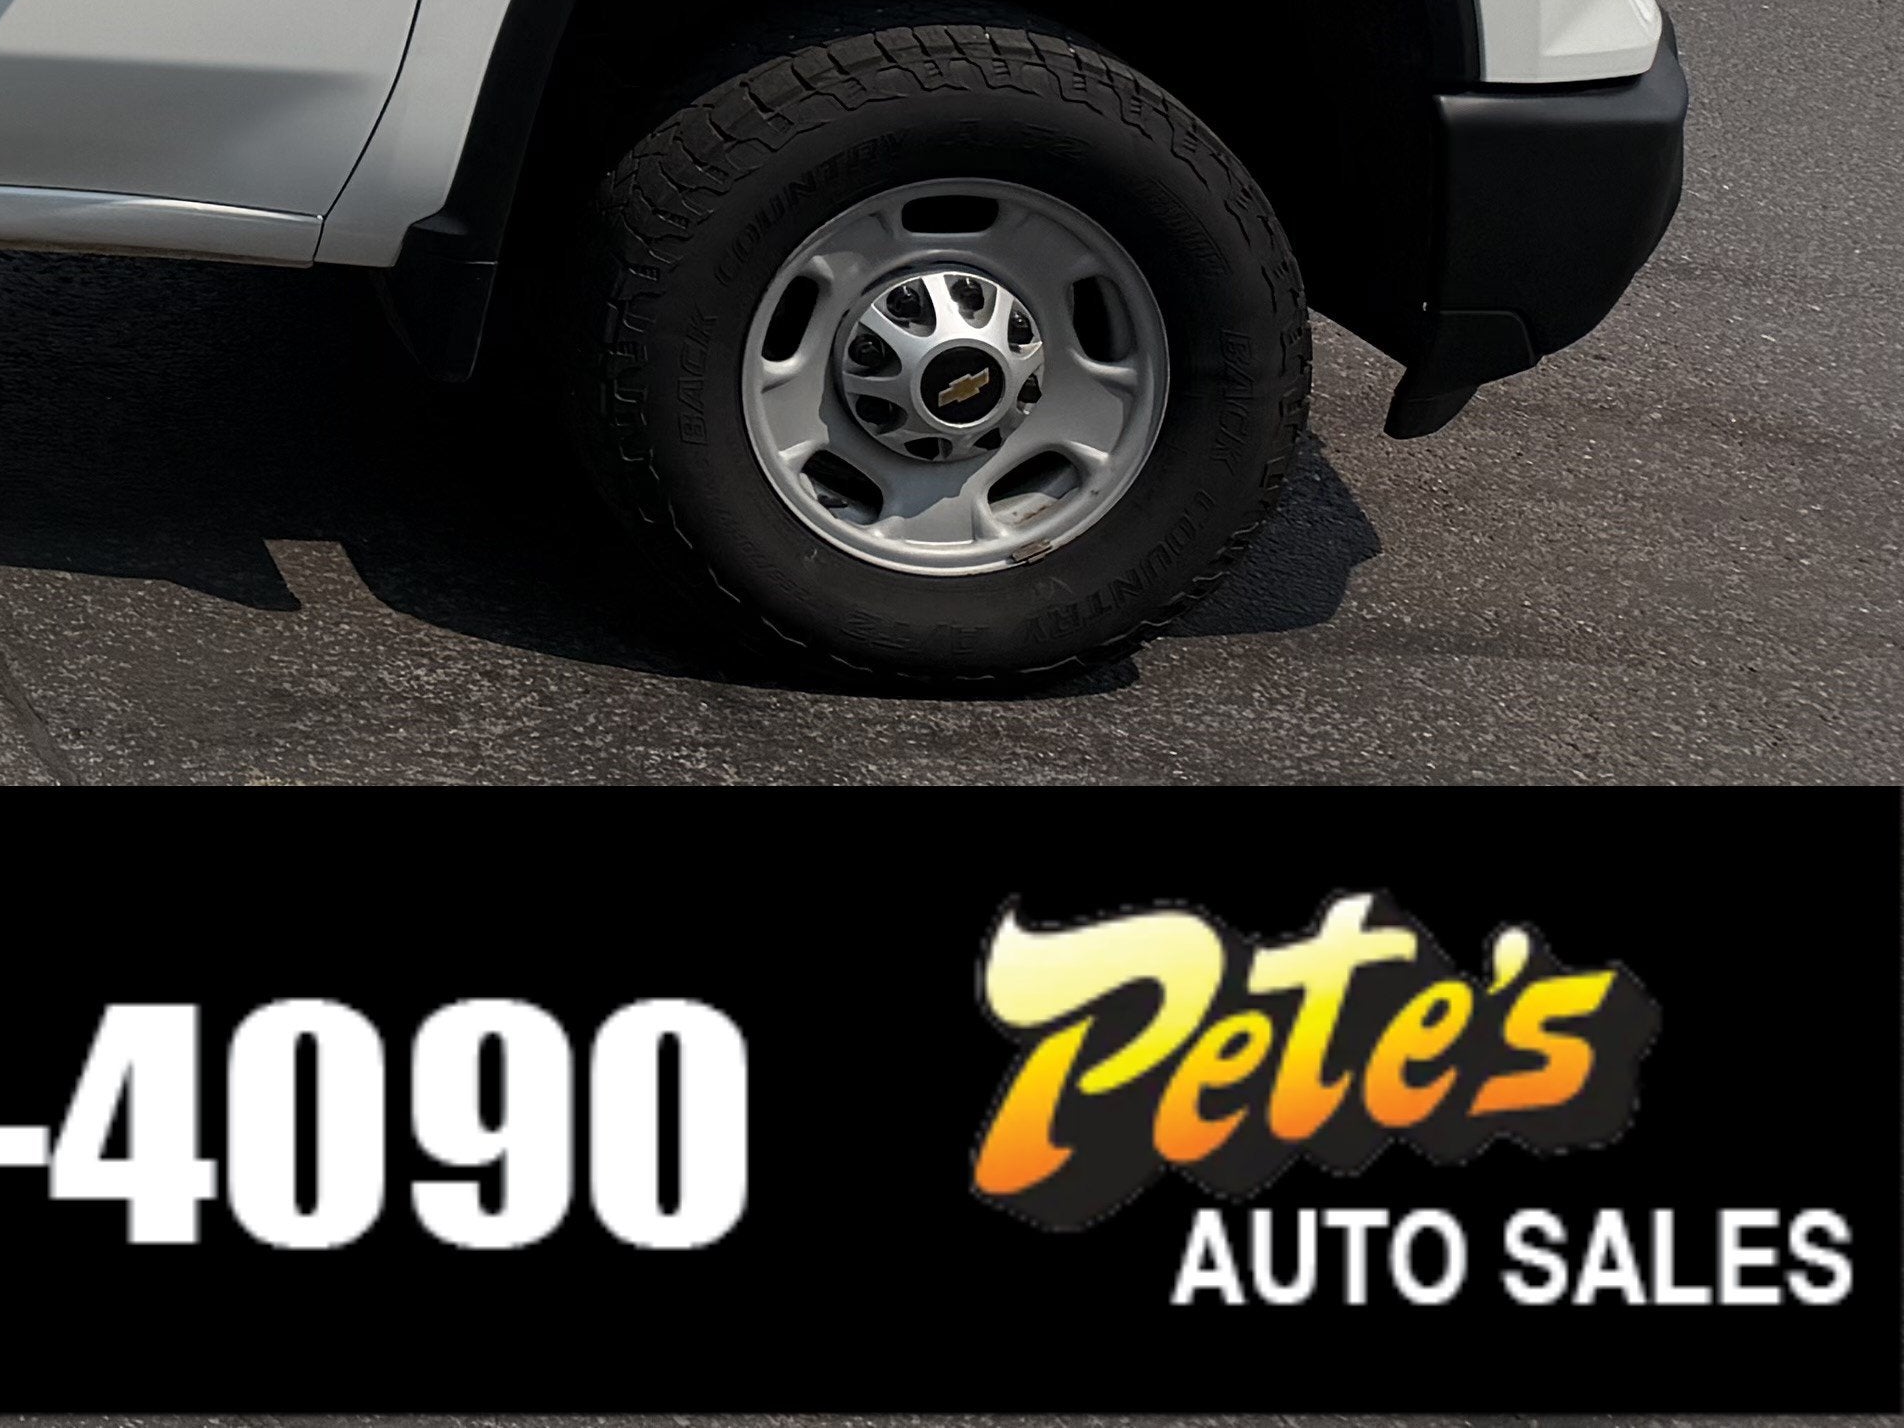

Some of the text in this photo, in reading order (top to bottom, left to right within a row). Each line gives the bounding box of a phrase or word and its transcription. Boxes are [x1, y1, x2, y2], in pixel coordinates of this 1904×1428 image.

[676, 310, 720, 446] BACK
[714, 129, 907, 289] COUNTRY
[1208, 328, 1256, 476] BACK
[1024, 488, 1217, 652] COUNTRY
